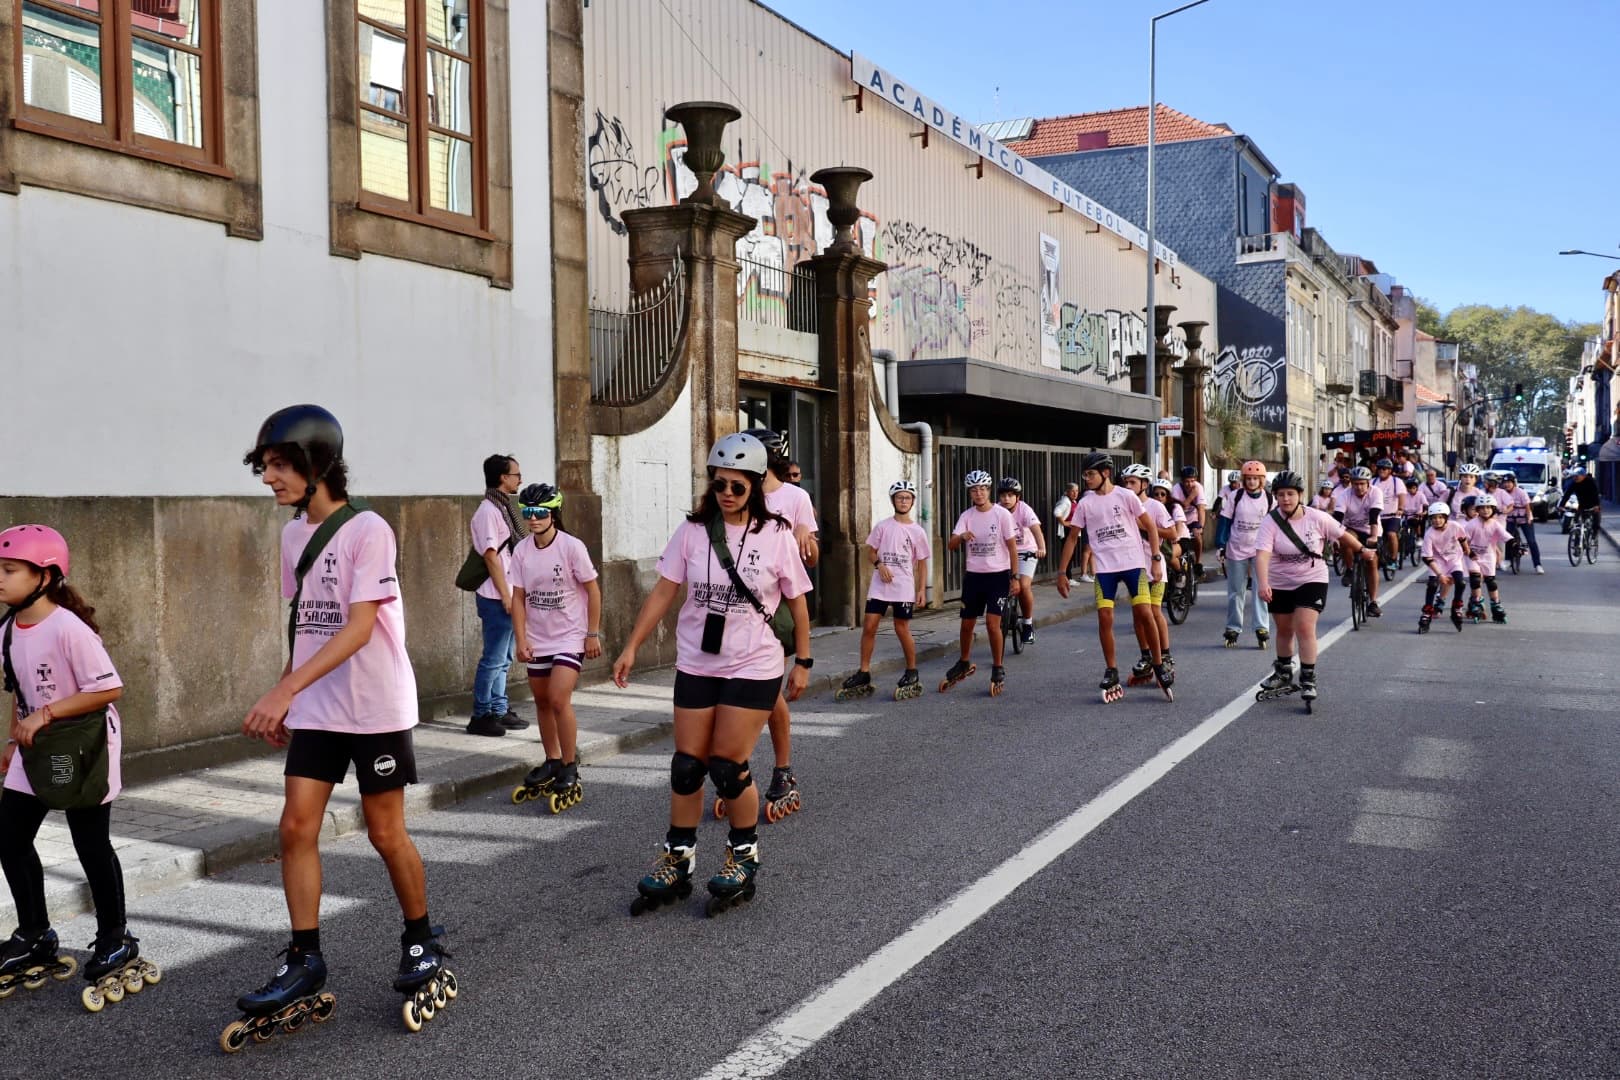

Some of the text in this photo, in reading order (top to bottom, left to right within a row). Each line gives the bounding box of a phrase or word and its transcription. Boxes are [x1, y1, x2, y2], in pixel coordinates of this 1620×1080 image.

[870, 70, 1175, 265] ACADÉMICO FUTEBOL CUBE
